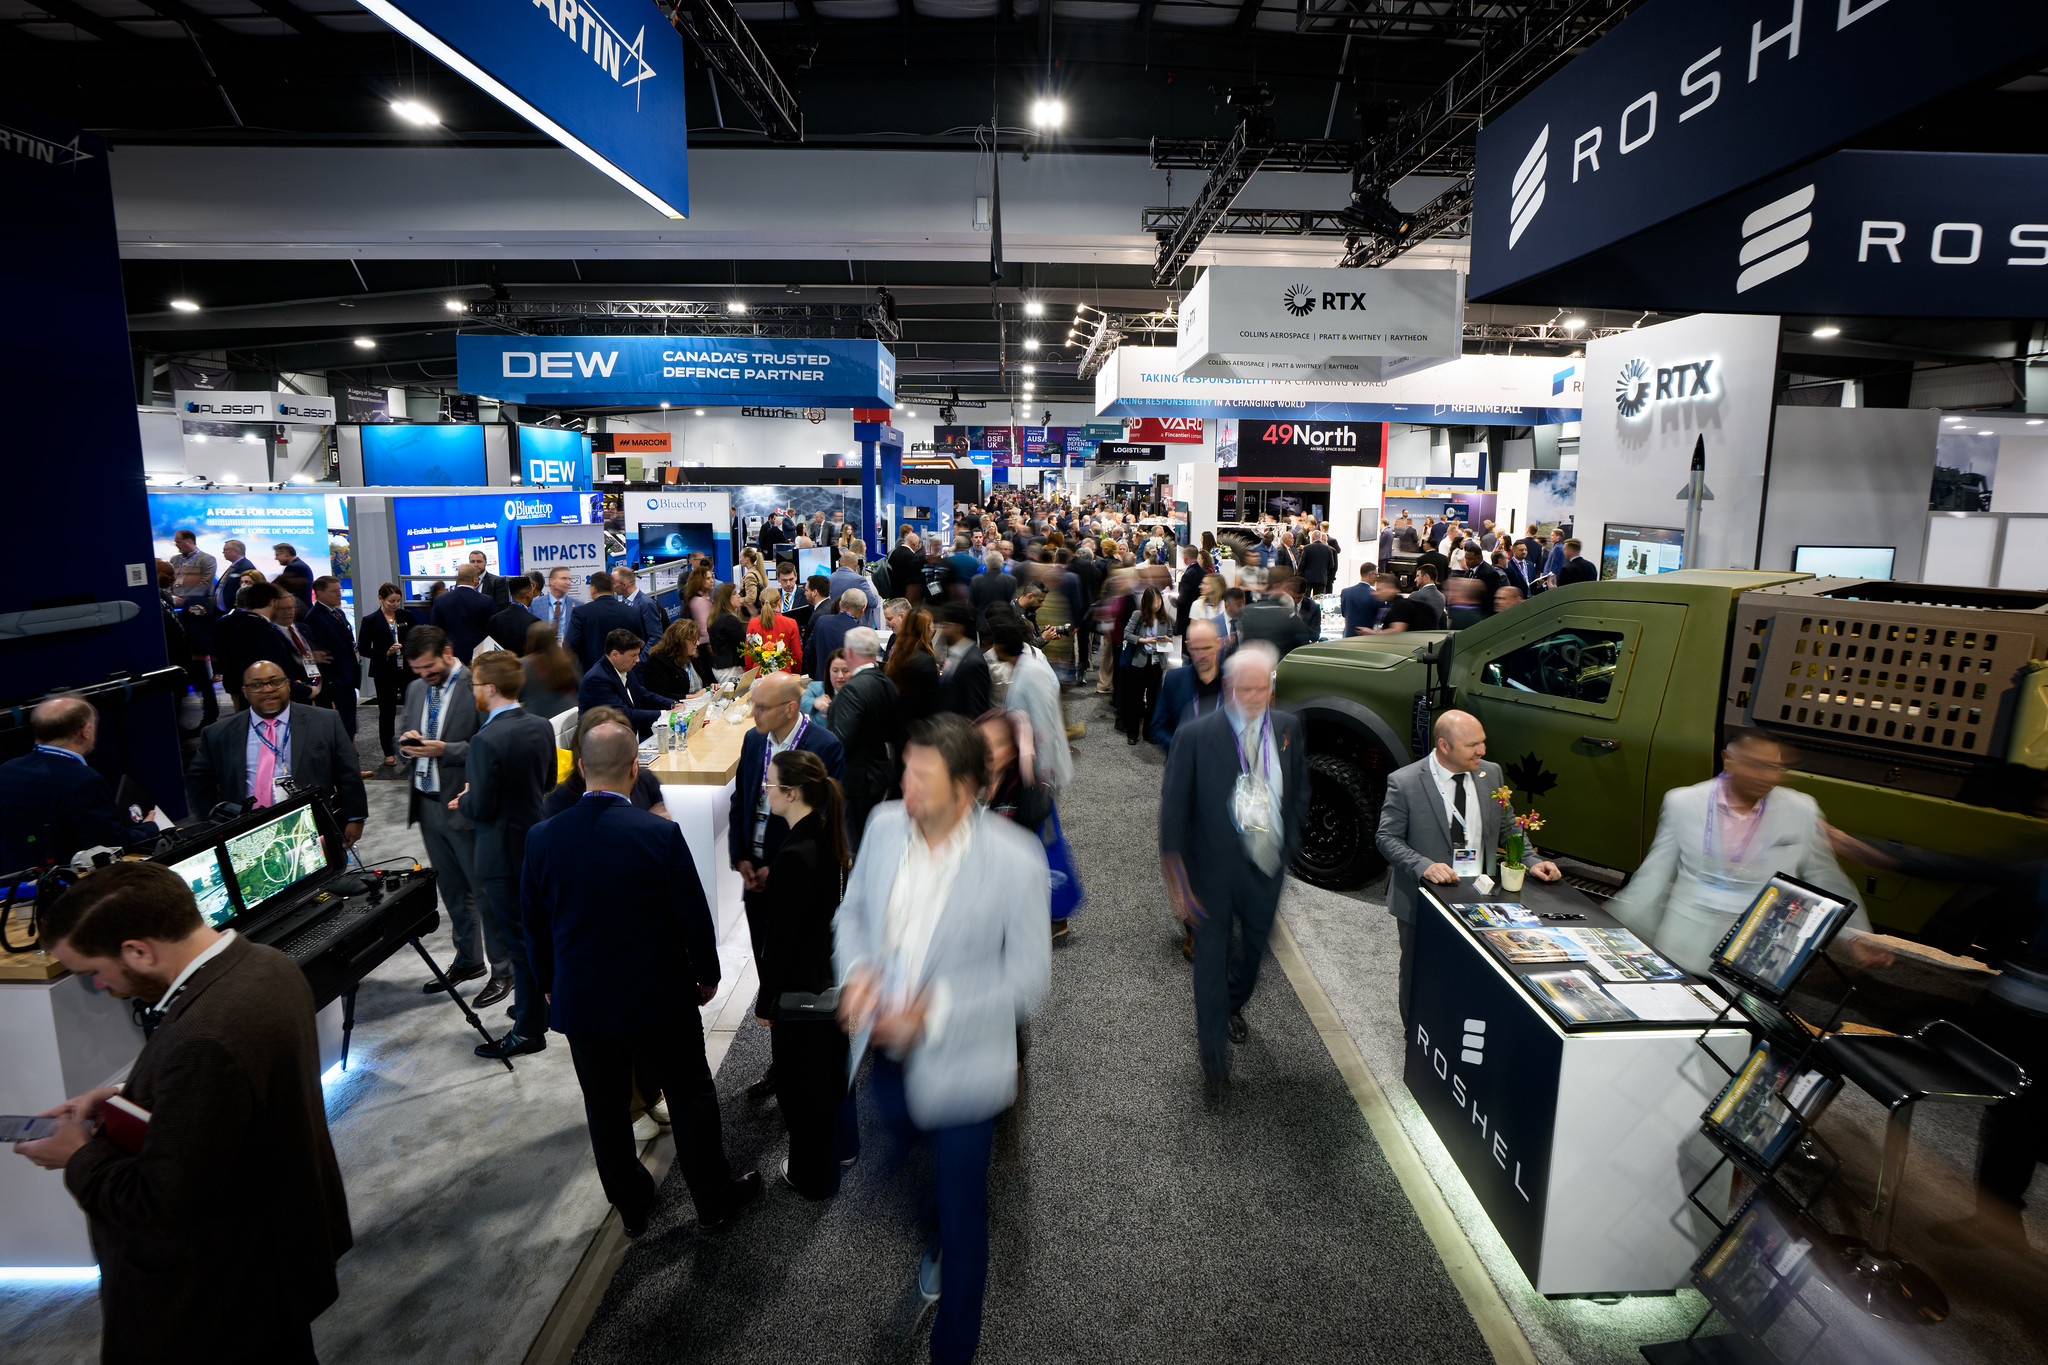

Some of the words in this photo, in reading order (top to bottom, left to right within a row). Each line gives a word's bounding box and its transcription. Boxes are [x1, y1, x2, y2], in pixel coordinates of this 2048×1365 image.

[1322, 292, 1366, 310] RTX
[1239, 330, 1268, 338] COLLINS
[1270, 331, 1310, 340] AEROSPACE
[1342, 333, 1347, 341] &
[1390, 334, 1428, 342] RAYTHEON
[502, 351, 619, 378] DEW
[662, 350, 748, 365] CANADA'S
[751, 352, 831, 366] TRUSTED
[662, 366, 740, 379] DEFENCE
[744, 368, 825, 381] PARTNER
[1140, 373, 1178, 383] TAKING
[1655, 359, 1714, 401] RTX
[1146, 398, 1212, 407] RESPONSIBILITY
[1214, 399, 1224, 407] IN
[1225, 399, 1232, 407] A
[1232, 399, 1275, 408] CHANGING
[1276, 400, 1306, 408] WORLD
[1451, 404, 1523, 414] RHEINMETALL
[1158, 417, 1203, 430] VARD
[1262, 424, 1357, 446] 49North
[530, 459, 576, 482] DEW
[516, 500, 553, 518] Bluedrop
[660, 498, 706, 510] Bluedrop
[207, 508, 214, 516] A
[215, 508, 245, 516] FORCE
[246, 508, 266, 516] FOR
[266, 508, 312, 516] PROGRESS
[533, 543, 596, 561] IMPACTS
[1416, 1024, 1530, 1202] ROSHEL
